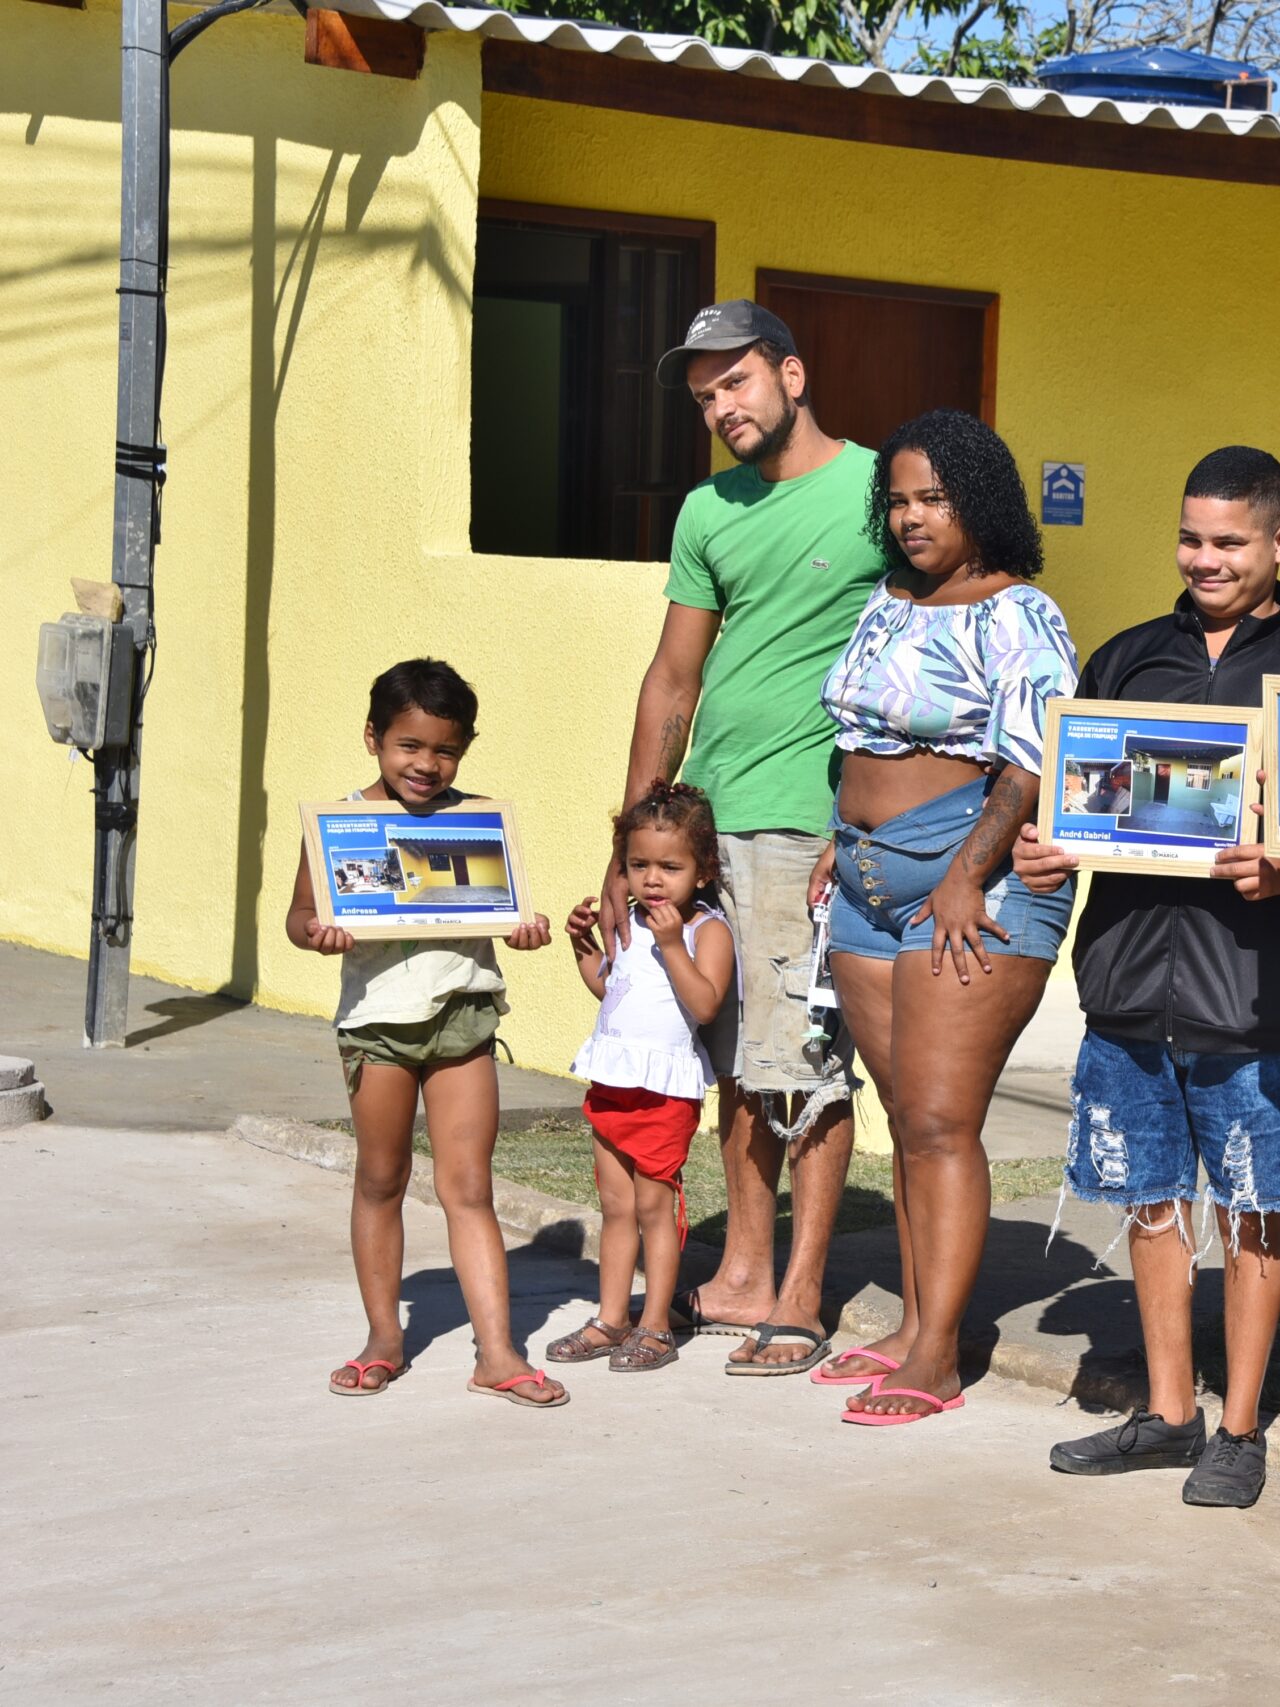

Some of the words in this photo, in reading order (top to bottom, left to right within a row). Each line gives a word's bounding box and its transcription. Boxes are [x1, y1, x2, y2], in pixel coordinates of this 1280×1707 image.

[1059, 830, 1081, 838] André
[1083, 831, 1111, 840] Gabriel
[341, 907, 378, 915] Andressa
